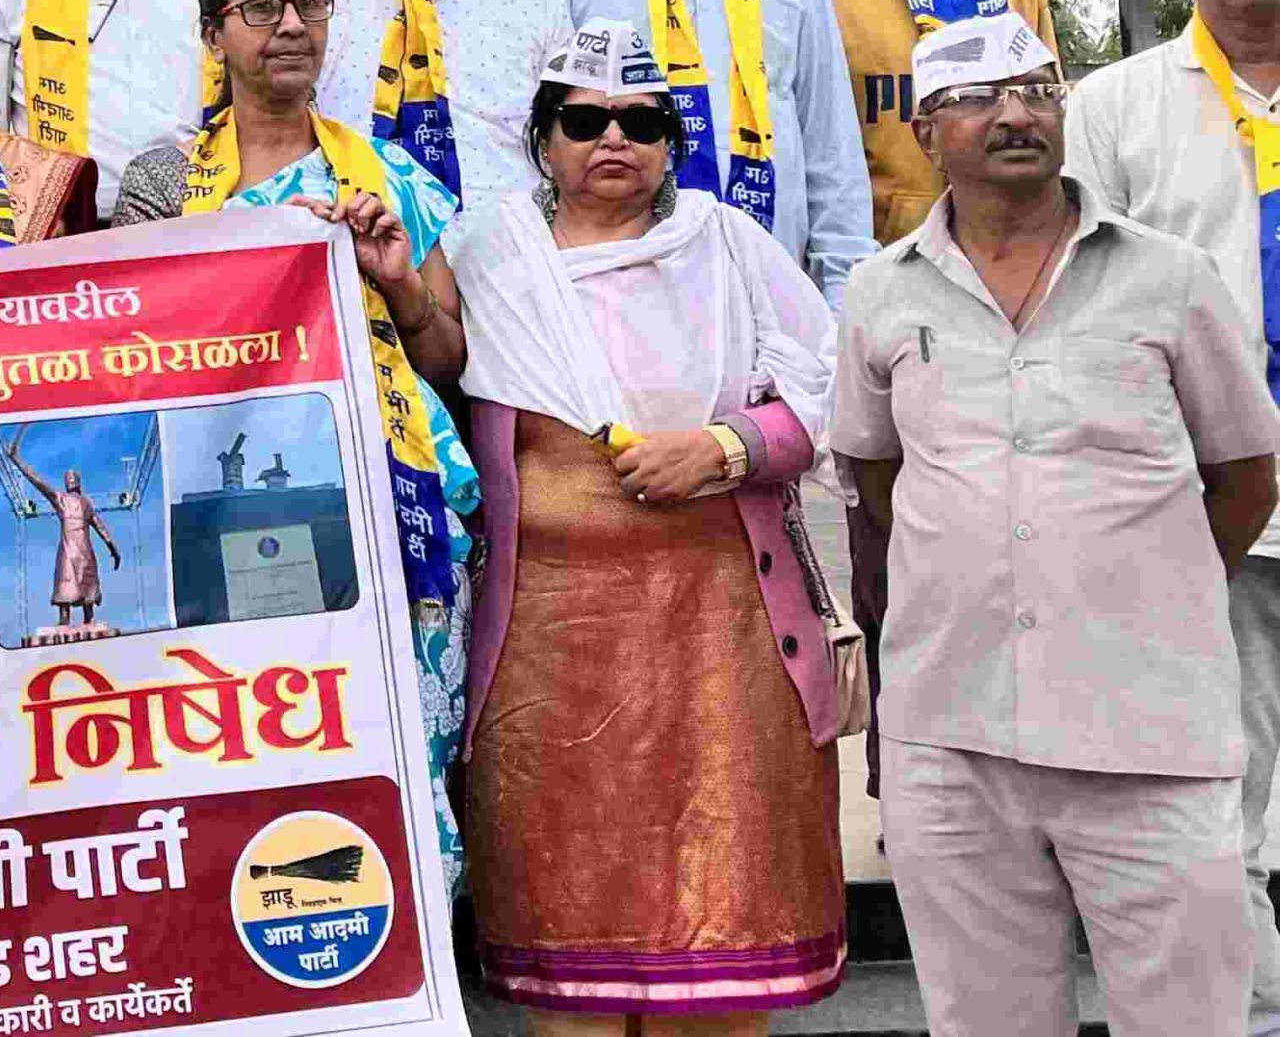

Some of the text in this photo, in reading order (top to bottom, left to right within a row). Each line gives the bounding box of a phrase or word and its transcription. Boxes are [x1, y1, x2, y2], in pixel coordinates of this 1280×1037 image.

[101, 328, 284, 378] कोसळला
[21, 649, 355, 786] निषेध
[41, 806, 190, 901] पार्टी
[260, 888, 298, 910] झाडू
[262, 910, 370, 947] आम आदमी
[23, 924, 130, 982] शहर
[298, 944, 340, 971] पार्टी
[57, 999, 81, 1026] व
